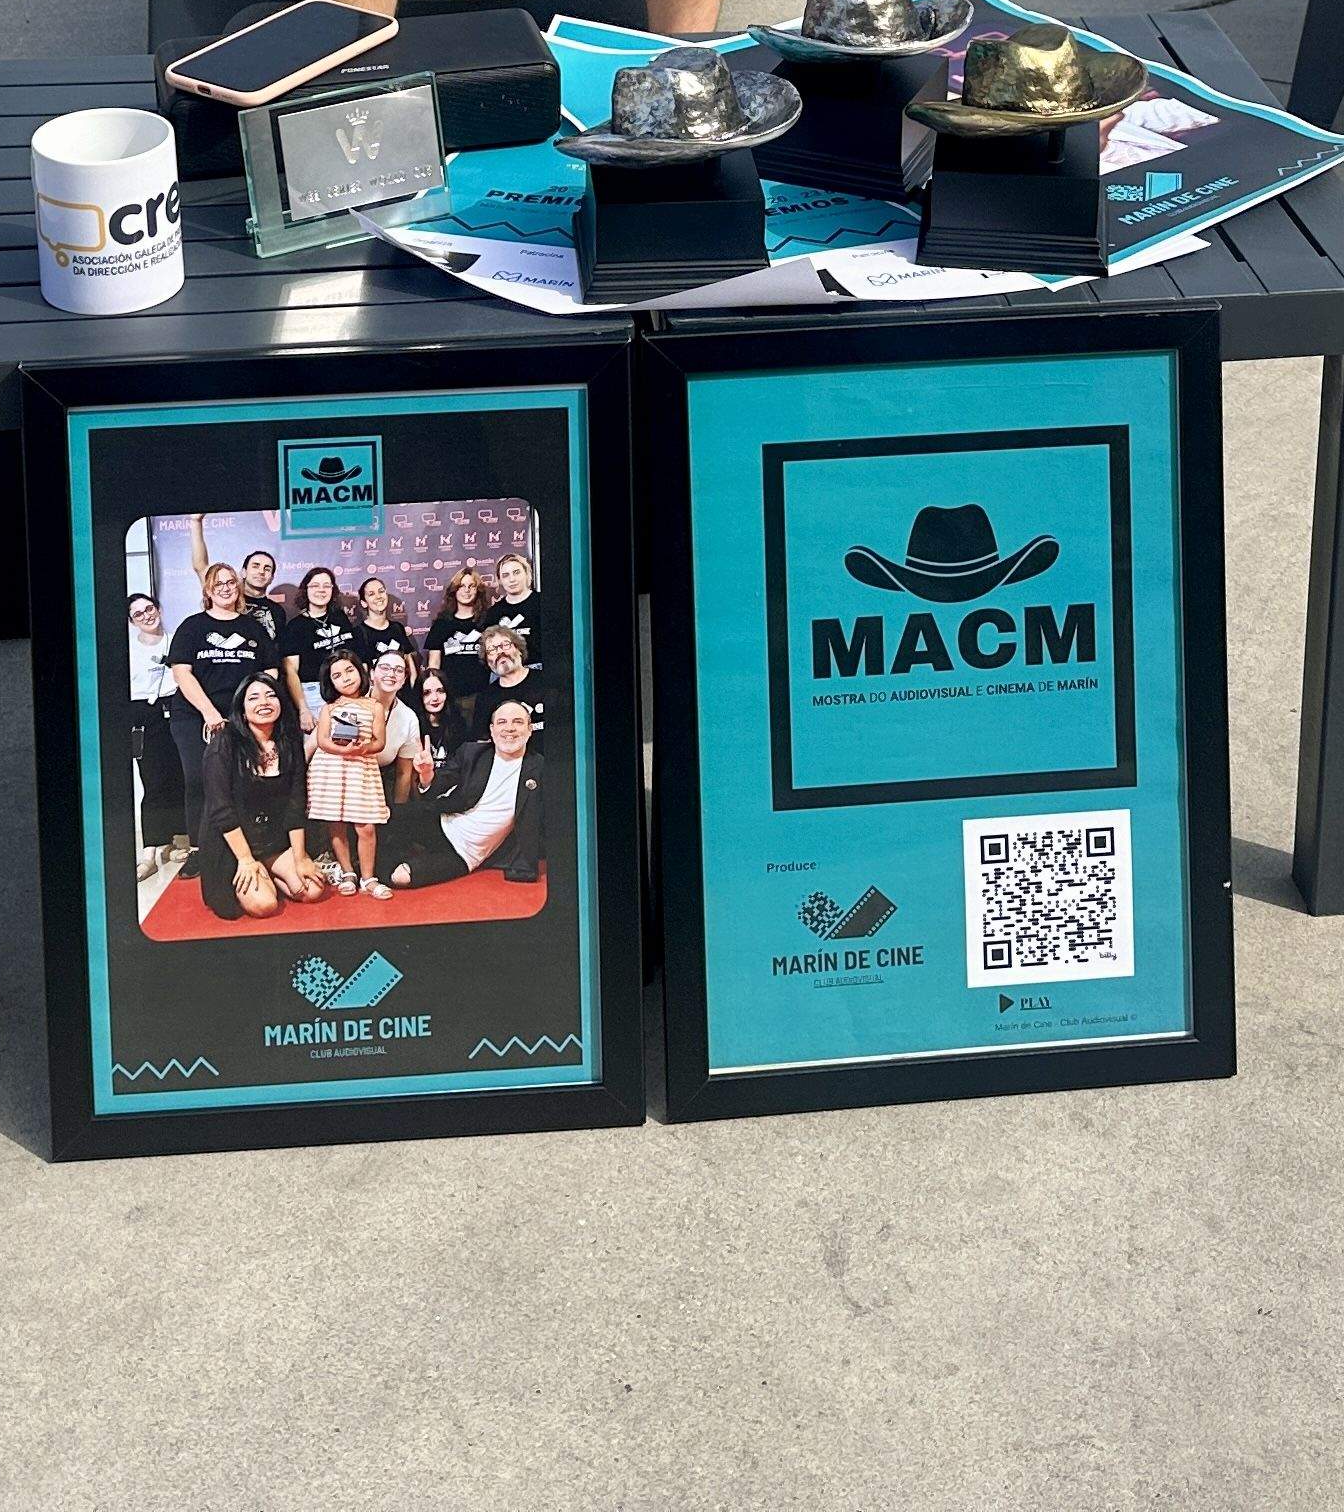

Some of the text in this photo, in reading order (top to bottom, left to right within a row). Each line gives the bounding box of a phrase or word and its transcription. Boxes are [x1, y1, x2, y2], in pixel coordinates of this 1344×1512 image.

[1118, 201, 1177, 226] MARÍN
[1171, 191, 1202, 205] DE
[1195, 176, 1240, 195] CINE
[72, 253, 133, 265] ASOCIACIÓN
[520, 249, 564, 259] Patrocina
[73, 267, 86, 276] DA
[88, 262, 141, 276] DIRECCIÓN
[292, 484, 373, 505] MACM
[812, 603, 1096, 679] MACM
[812, 676, 1099, 706] MOSTRA DO AUDIOVISUAL E CINEMA DE MARÍN
[772, 946, 924, 976] MARÍN DE CINE
[1020, 996, 1052, 1009] PLAY
[264, 1015, 432, 1046] MARÍN DE CINE
[1060, 1018, 1079, 1027] Club
[310, 1045, 388, 1059] CLUB AUDIOVISUAL
